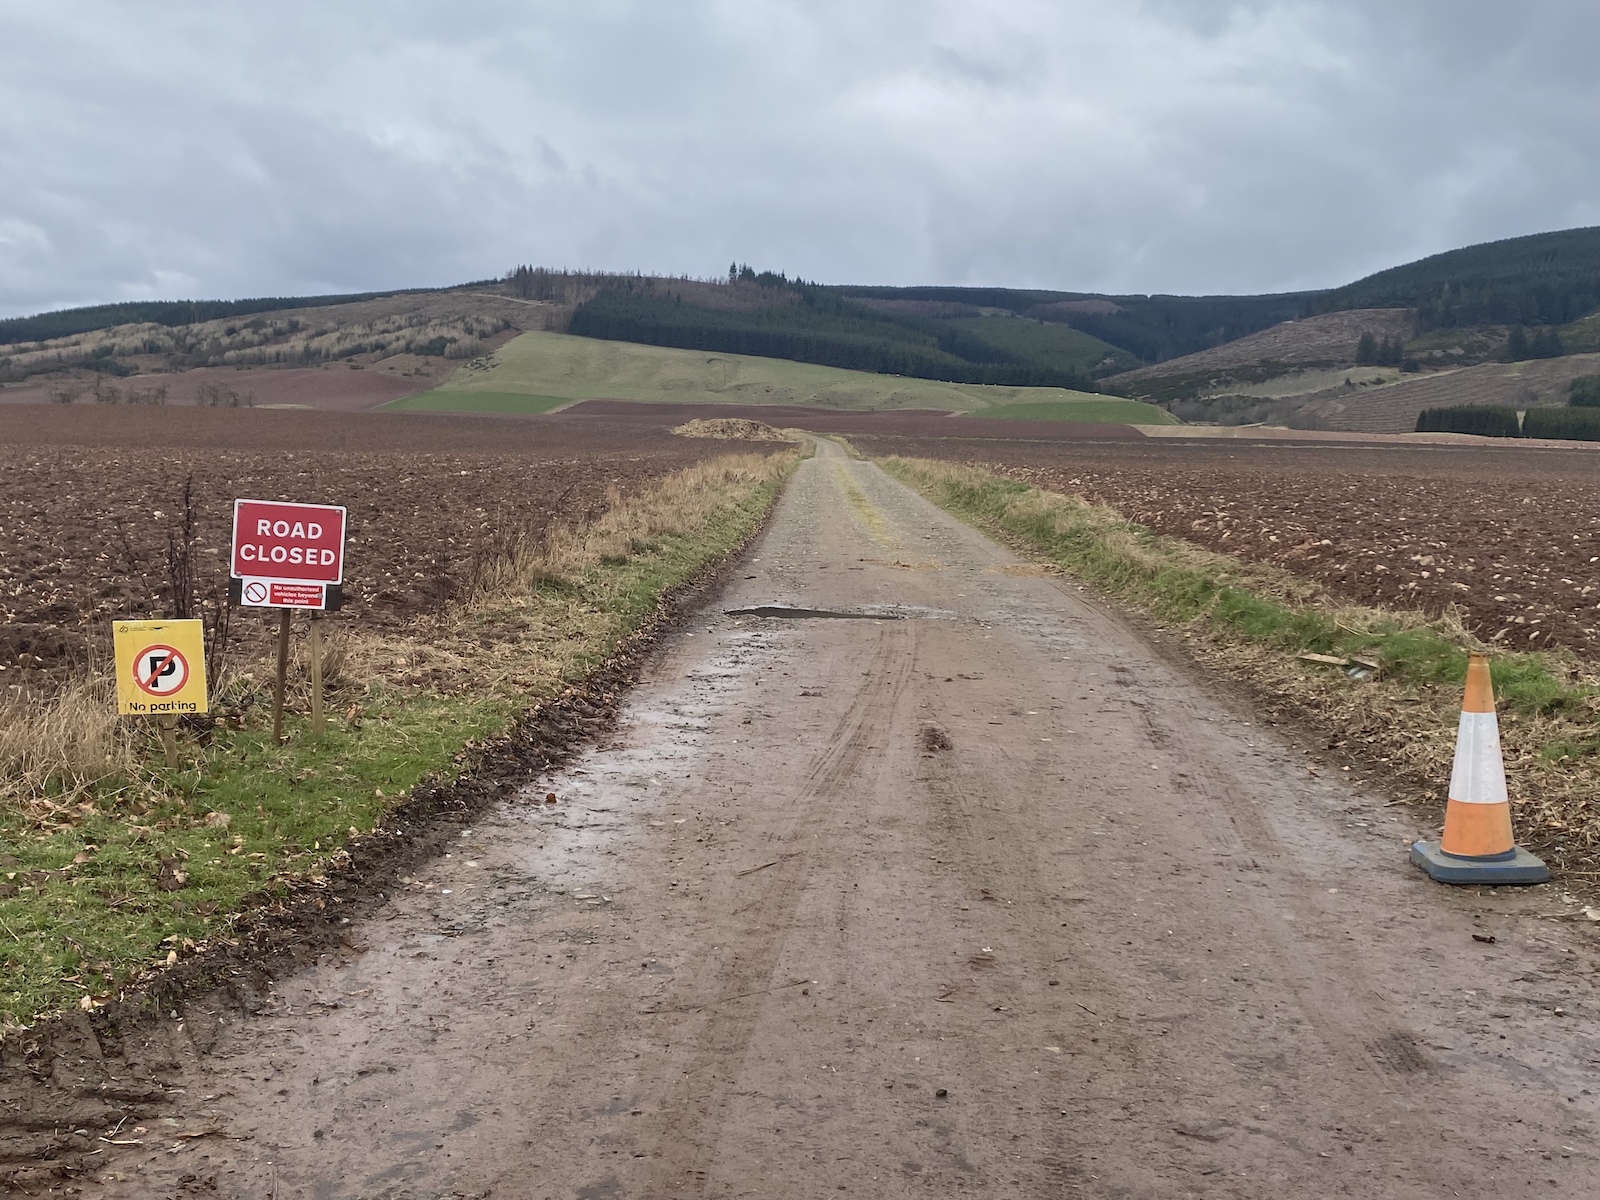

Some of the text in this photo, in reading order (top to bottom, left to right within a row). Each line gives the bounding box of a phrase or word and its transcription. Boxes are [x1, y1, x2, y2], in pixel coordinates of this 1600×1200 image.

[256, 518, 323, 540] ROAD
[239, 543, 336, 566] CLOSED
[149, 656, 176, 688] P
[129, 700, 197, 713] No parking
